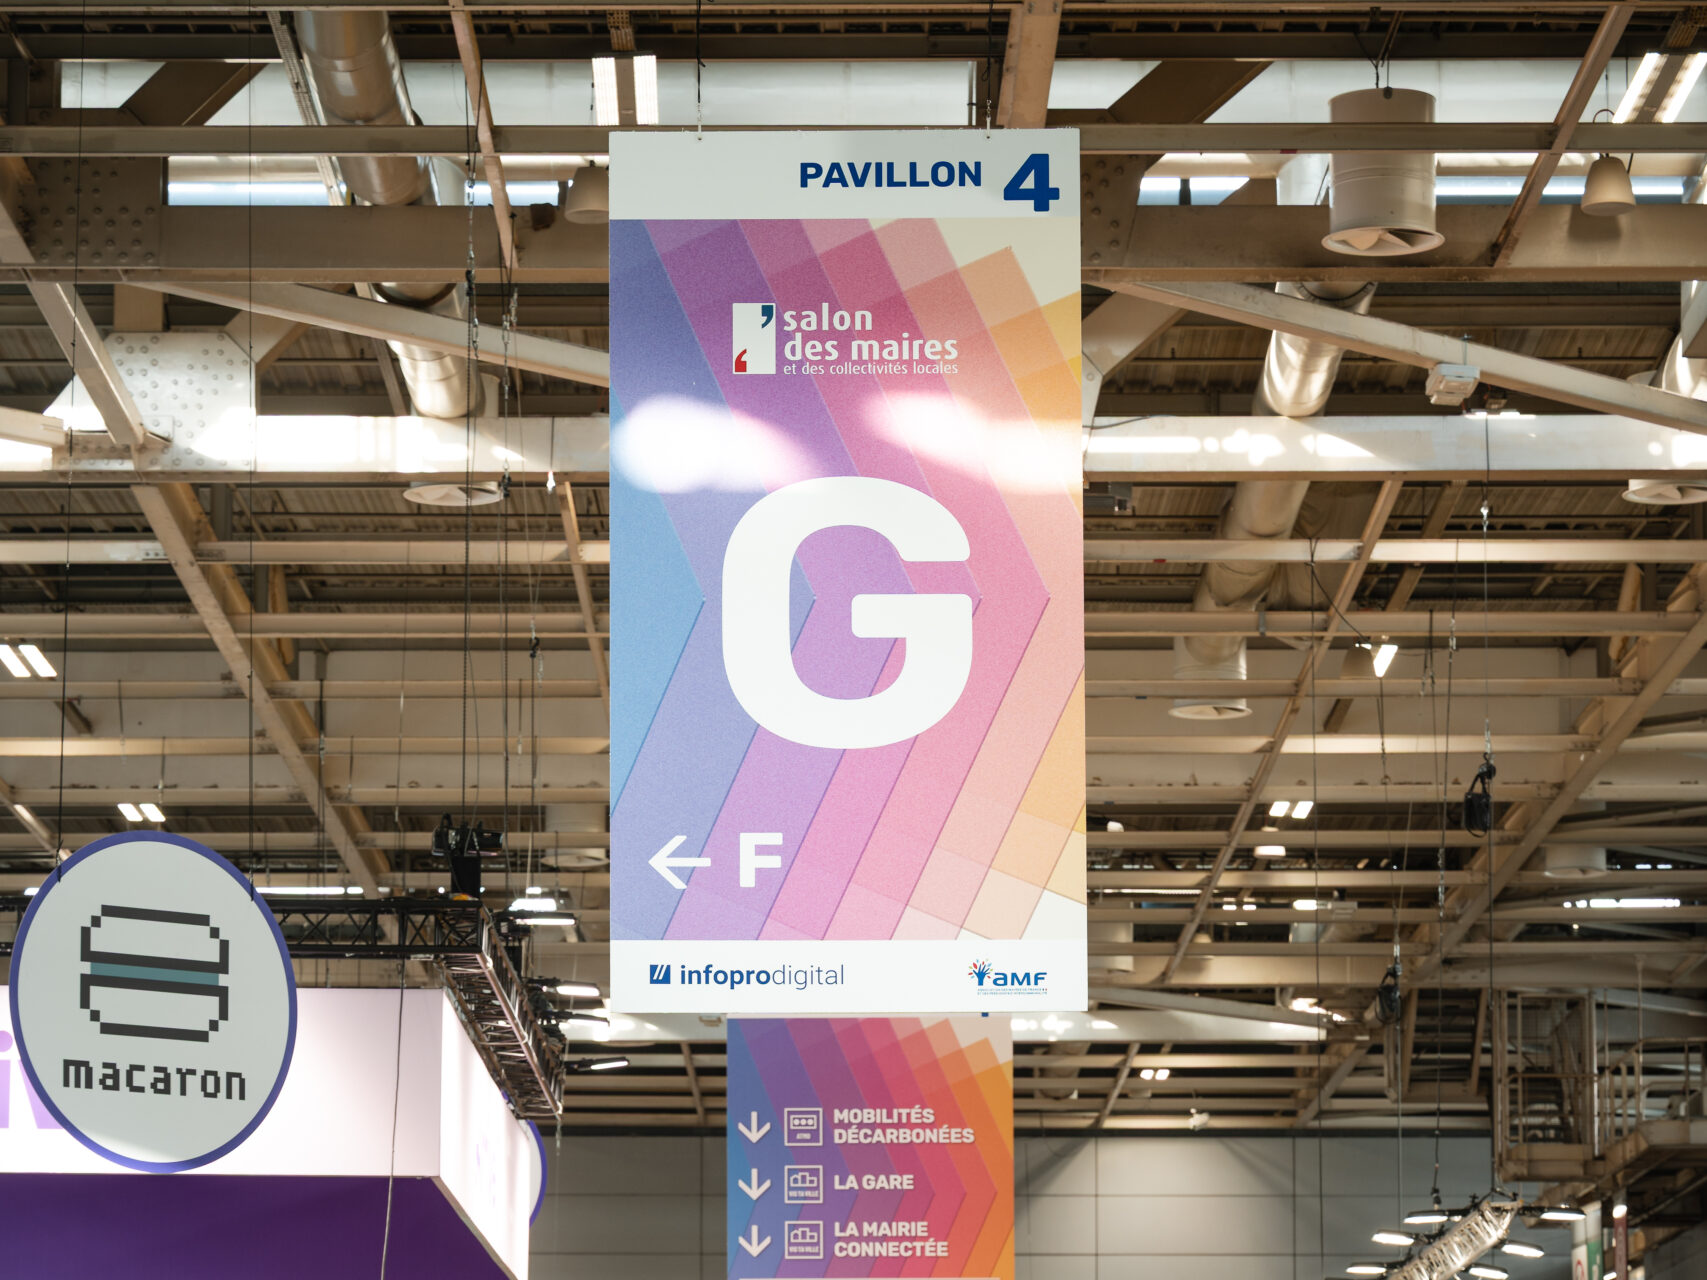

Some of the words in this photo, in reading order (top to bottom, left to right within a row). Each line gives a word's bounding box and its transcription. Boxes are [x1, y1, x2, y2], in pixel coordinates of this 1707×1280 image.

[800, 161, 982, 188] PAVILLON
[1003, 153, 1060, 212] 4
[783, 302, 873, 331] salon
[784, 332, 839, 361] des
[851, 332, 958, 361] maires
[783, 364, 797, 375] et
[801, 362, 825, 375] des
[829, 361, 908, 375] collectivités
[913, 361, 959, 375] locales
[721, 476, 973, 749] G
[739, 832, 783, 887] F
[680, 964, 844, 991] infoprodigital
[62, 1058, 246, 1101] macaron
[833, 1105, 936, 1124] MOBILITÉS
[833, 1124, 976, 1144] DÉCARBONÉES
[833, 1174, 859, 1190] LA
[862, 1174, 915, 1190] GARE
[833, 1221, 860, 1237] LA
[863, 1221, 929, 1237] MAIRIE
[833, 1238, 949, 1258] CONNECTÉE
